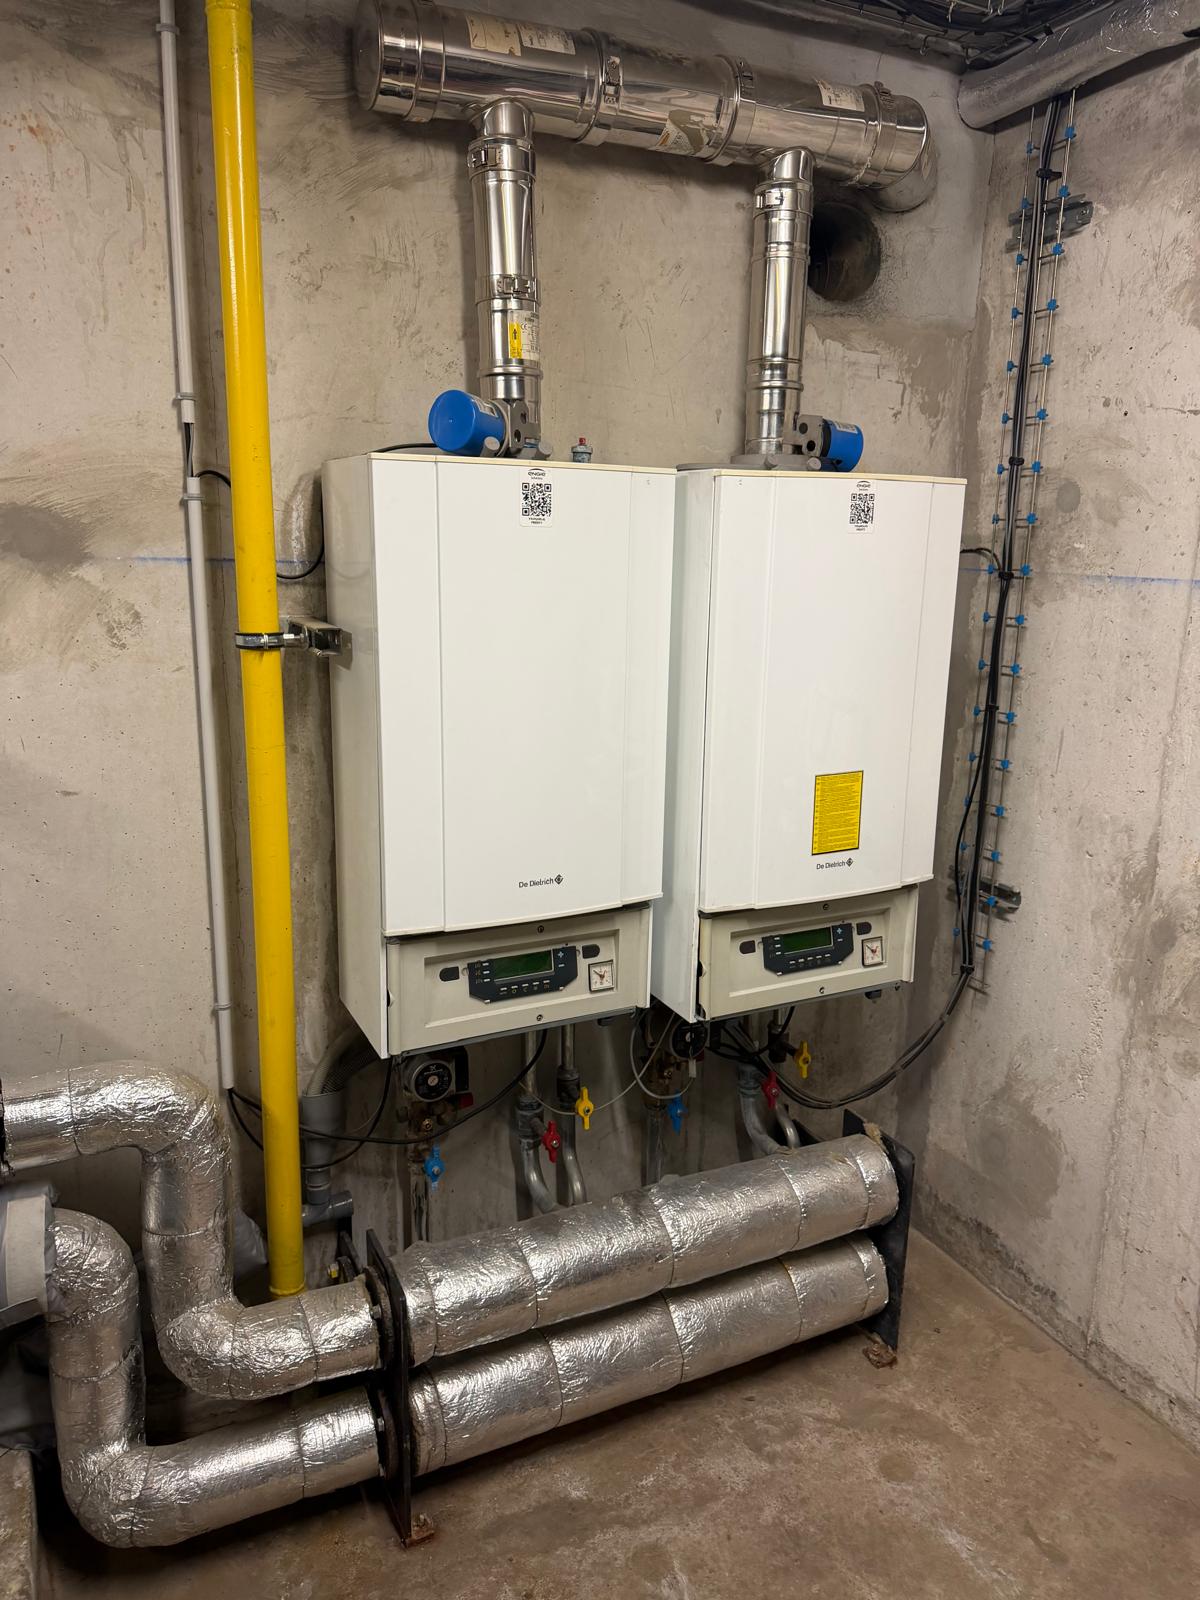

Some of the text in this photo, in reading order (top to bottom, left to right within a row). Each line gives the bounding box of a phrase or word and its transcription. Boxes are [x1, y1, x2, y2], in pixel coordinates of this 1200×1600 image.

[825, 860, 846, 869] Dietrich
[518, 877, 554, 889] De Dietrich
